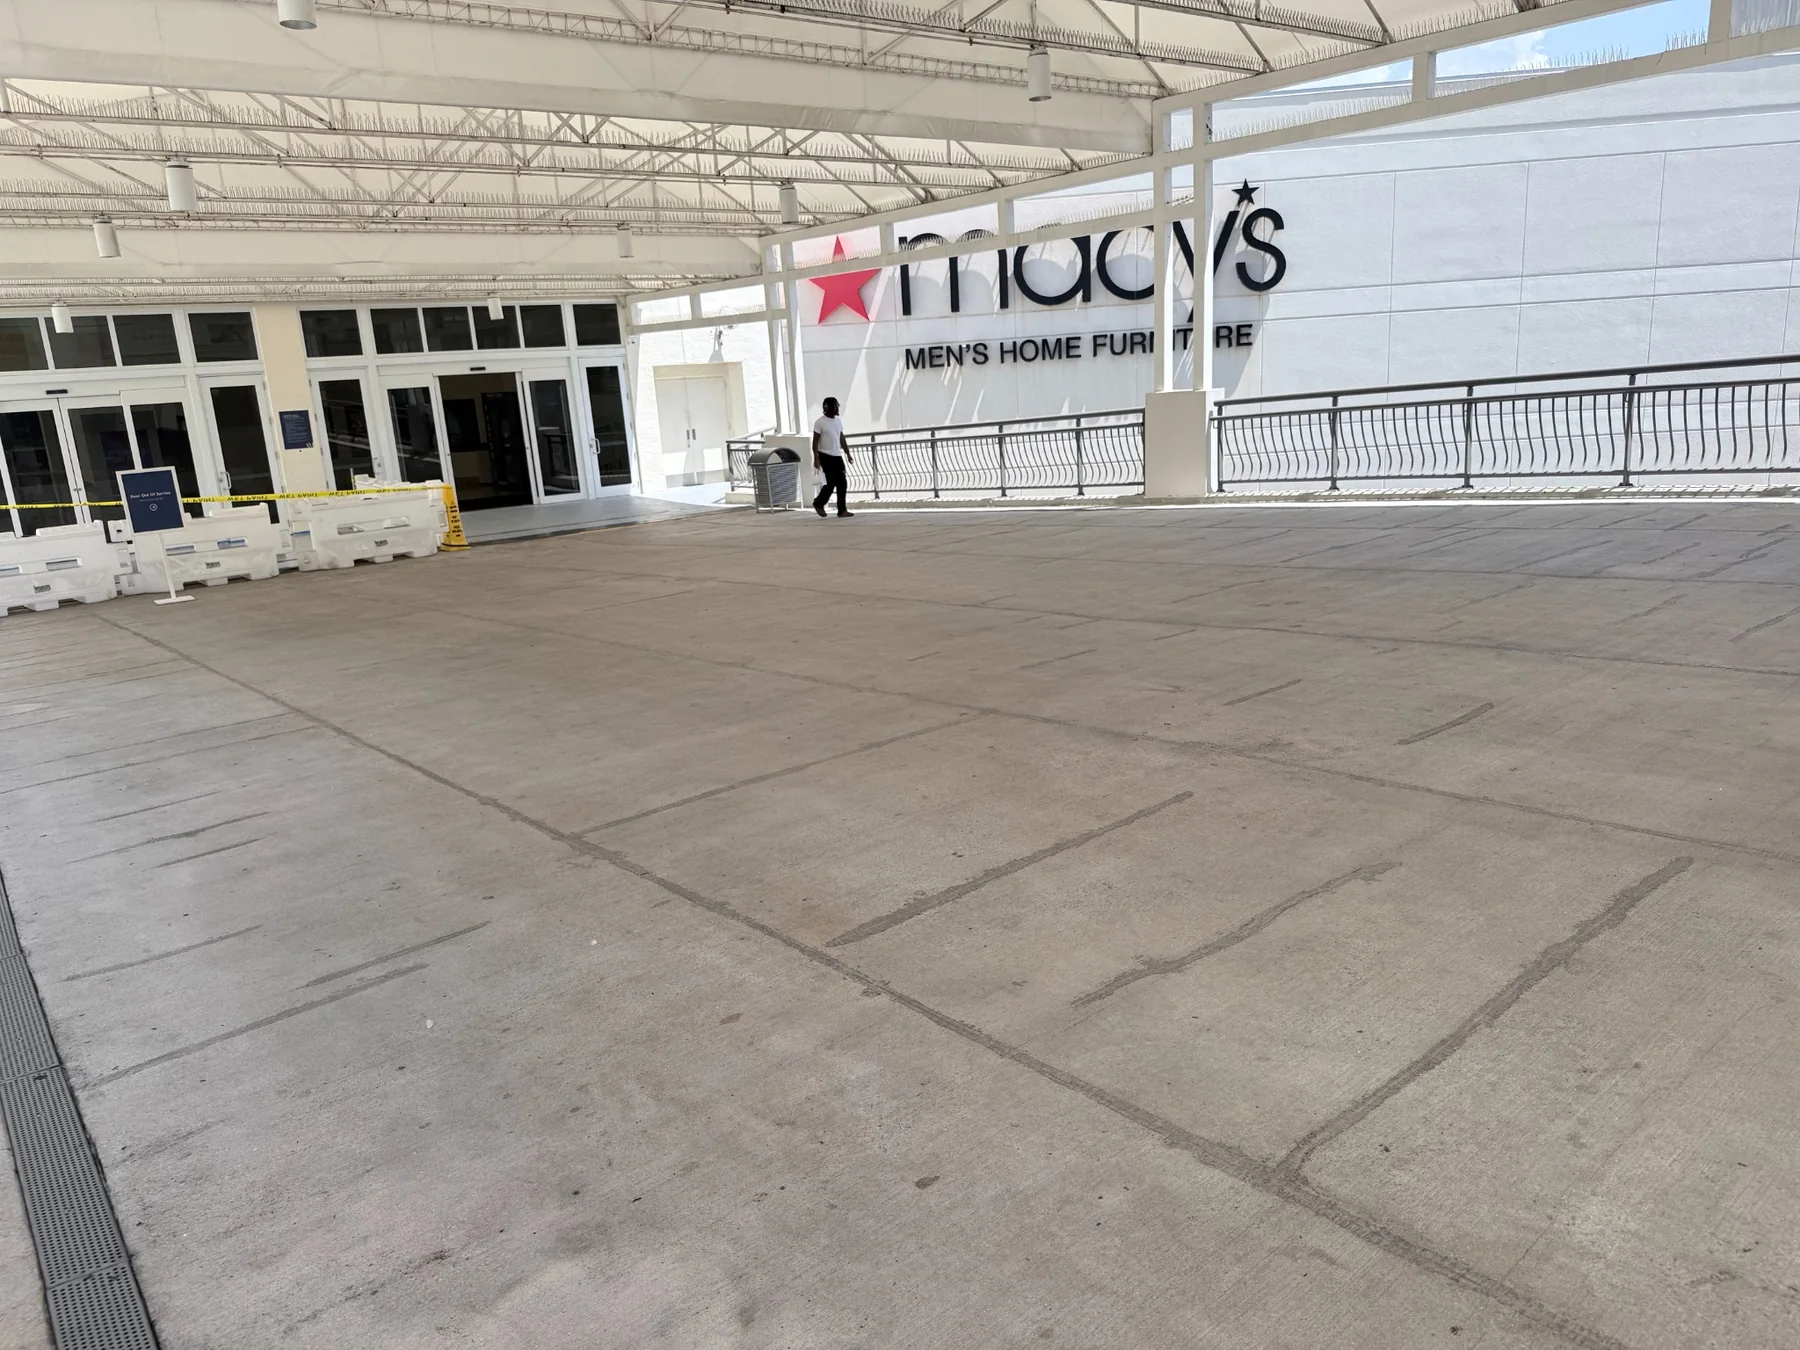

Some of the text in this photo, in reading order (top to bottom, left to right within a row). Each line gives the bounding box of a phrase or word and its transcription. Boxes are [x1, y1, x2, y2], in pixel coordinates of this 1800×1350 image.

[905, 323, 1254, 371] MEN'S HOME FURTRE
